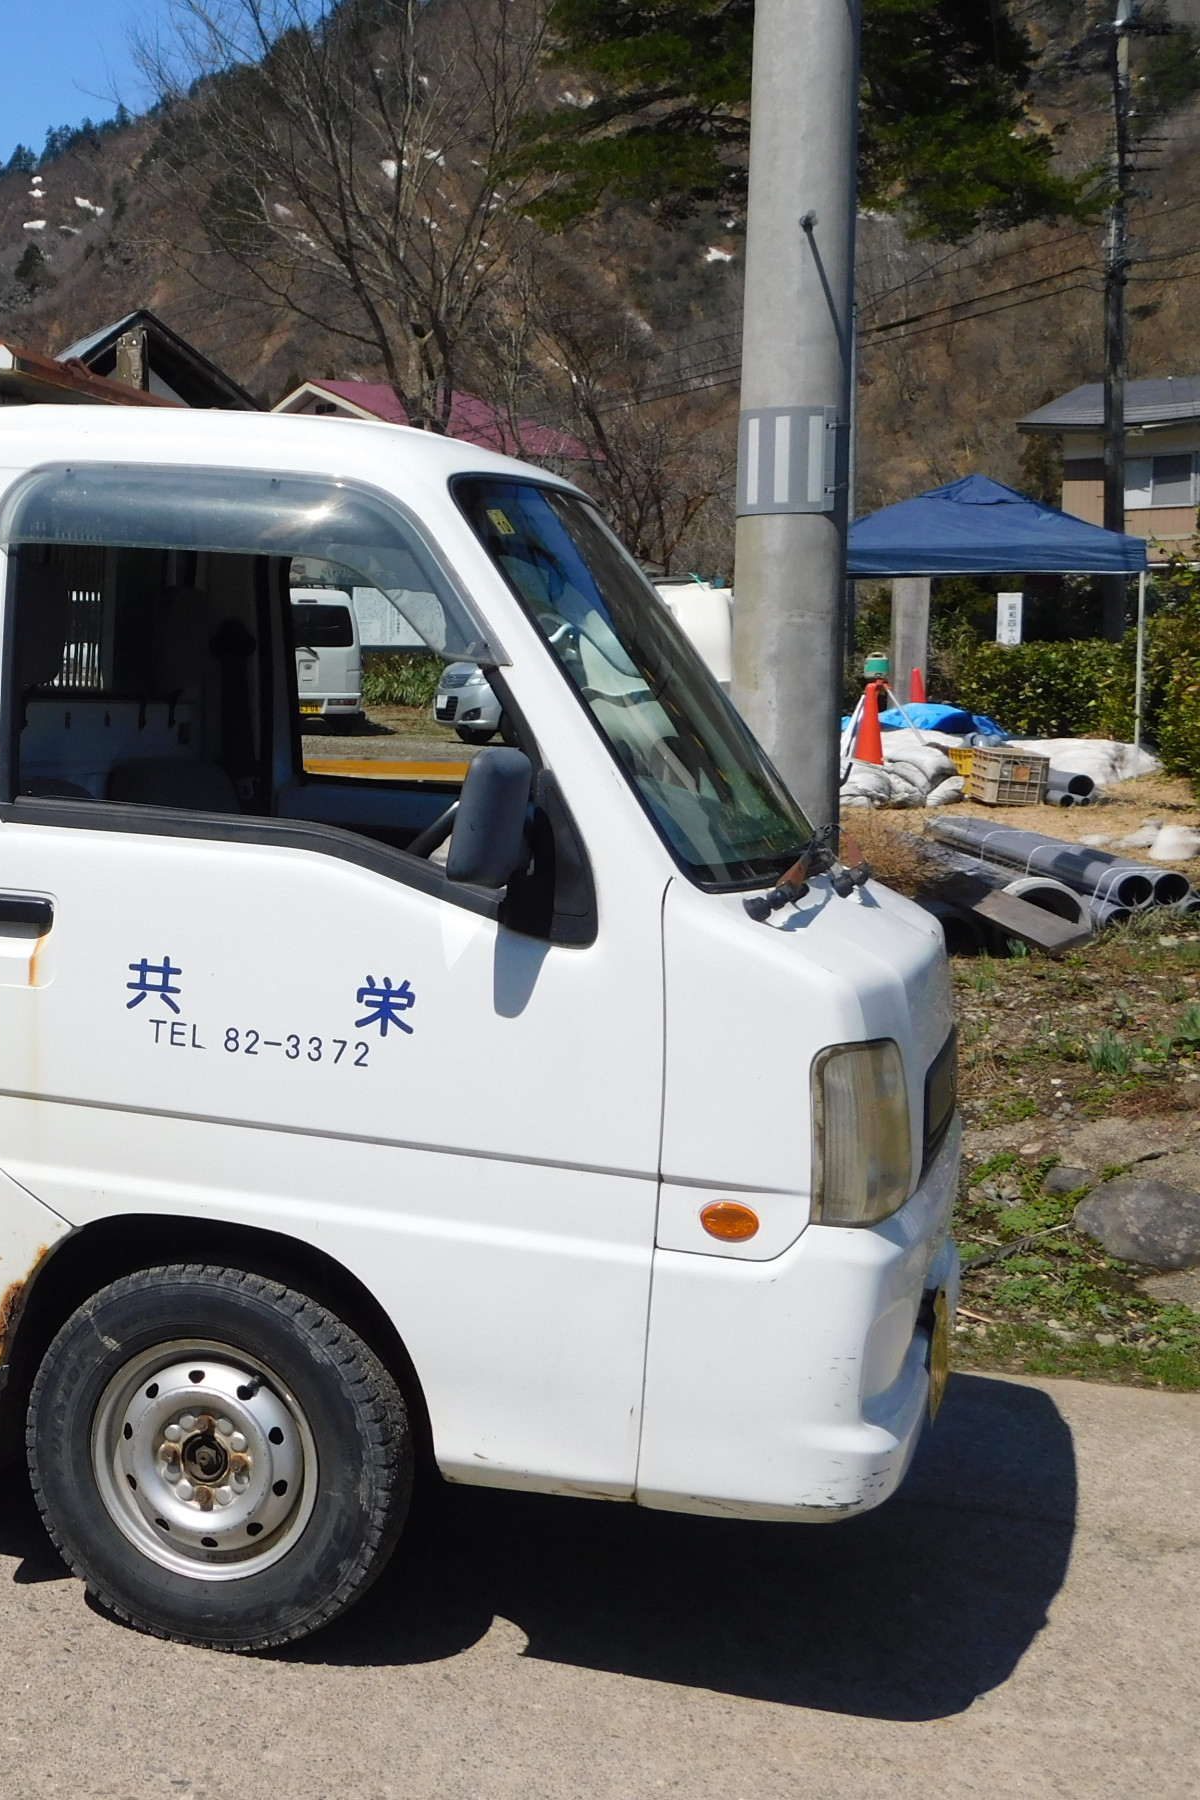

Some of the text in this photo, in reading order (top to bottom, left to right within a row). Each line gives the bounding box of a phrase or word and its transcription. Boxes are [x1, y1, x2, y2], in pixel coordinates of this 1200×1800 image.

[126, 955, 416, 1037] 共 栄
[148, 1018, 370, 1067] TEL 82-3372
